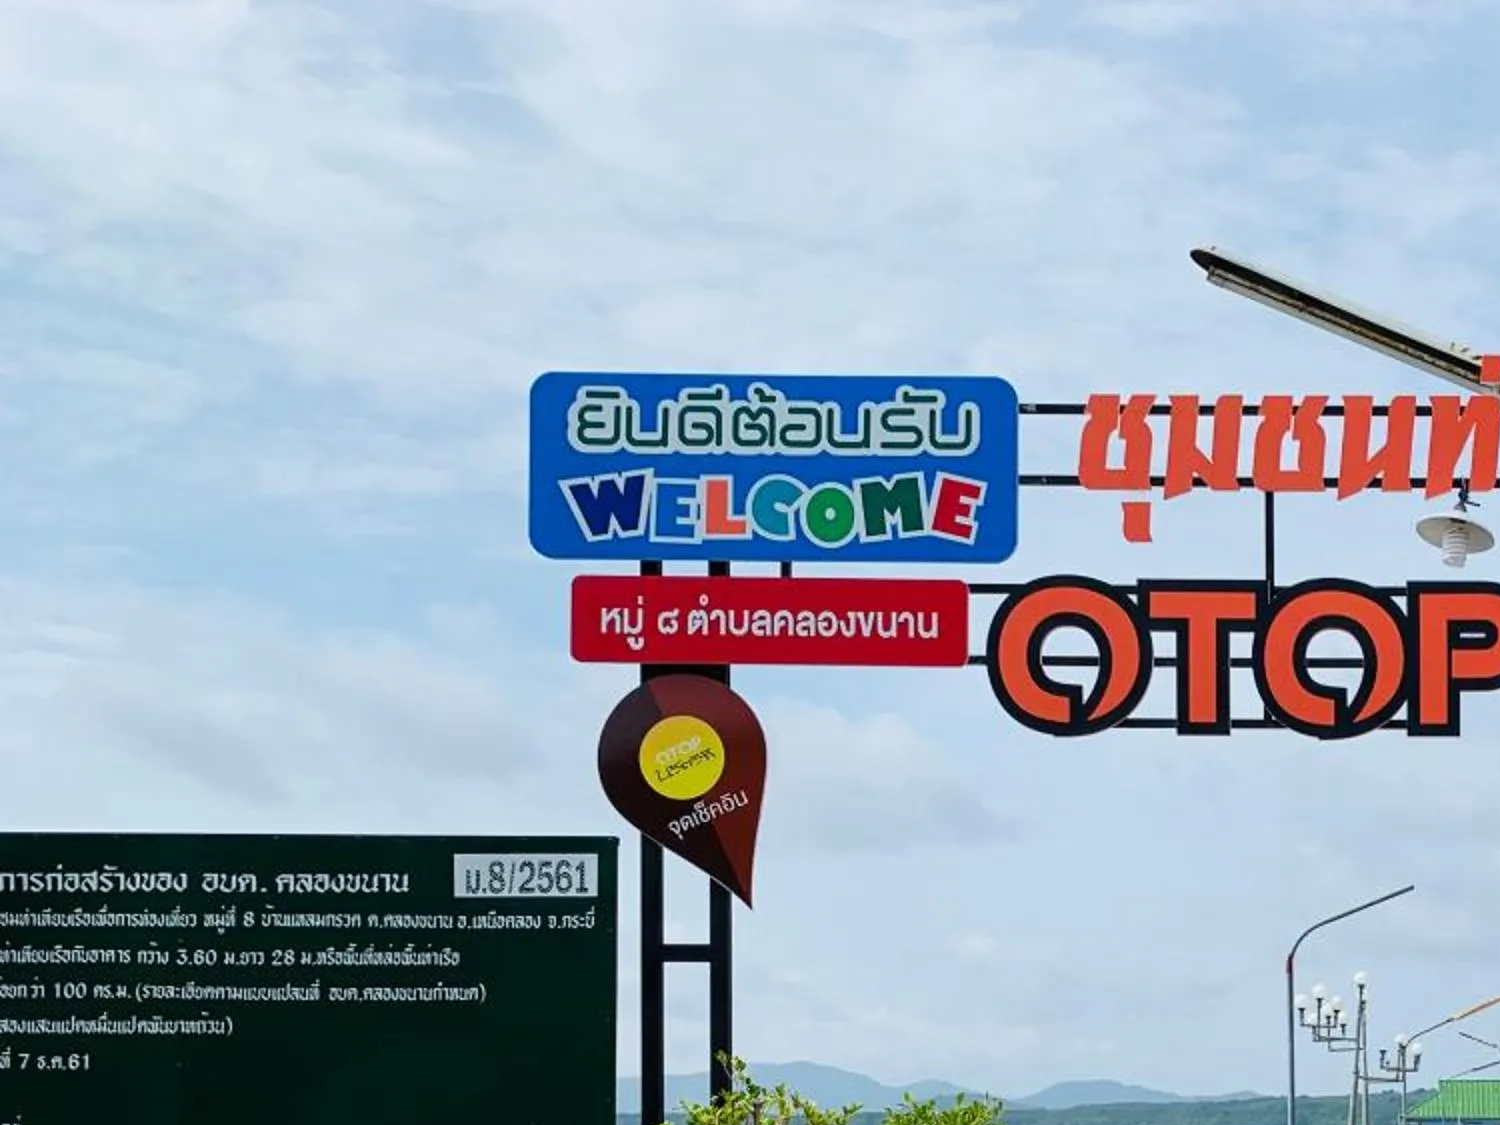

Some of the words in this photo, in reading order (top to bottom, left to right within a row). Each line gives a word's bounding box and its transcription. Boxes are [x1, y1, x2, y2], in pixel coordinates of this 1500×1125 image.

[568, 383, 980, 455] ยินดีต้อนรับ
[558, 468, 988, 546] WELCOME
[601, 595, 644, 650] หมู่
[658, 613, 680, 634] ๘
[688, 595, 939, 639] ตำบลคลองขนาน
[668, 789, 749, 840] จุดเช็คอิน
[275, 874, 409, 893] คลองขนาน
[464, 860, 590, 895] ม.8/2561
[243, 912, 254, 927] 8
[138, 942, 169, 964] กว้าง
[176, 949, 217, 965] 3.60
[272, 949, 295, 966] 28
[55, 982, 86, 999] 100
[19, 1054, 30, 1069] 7
